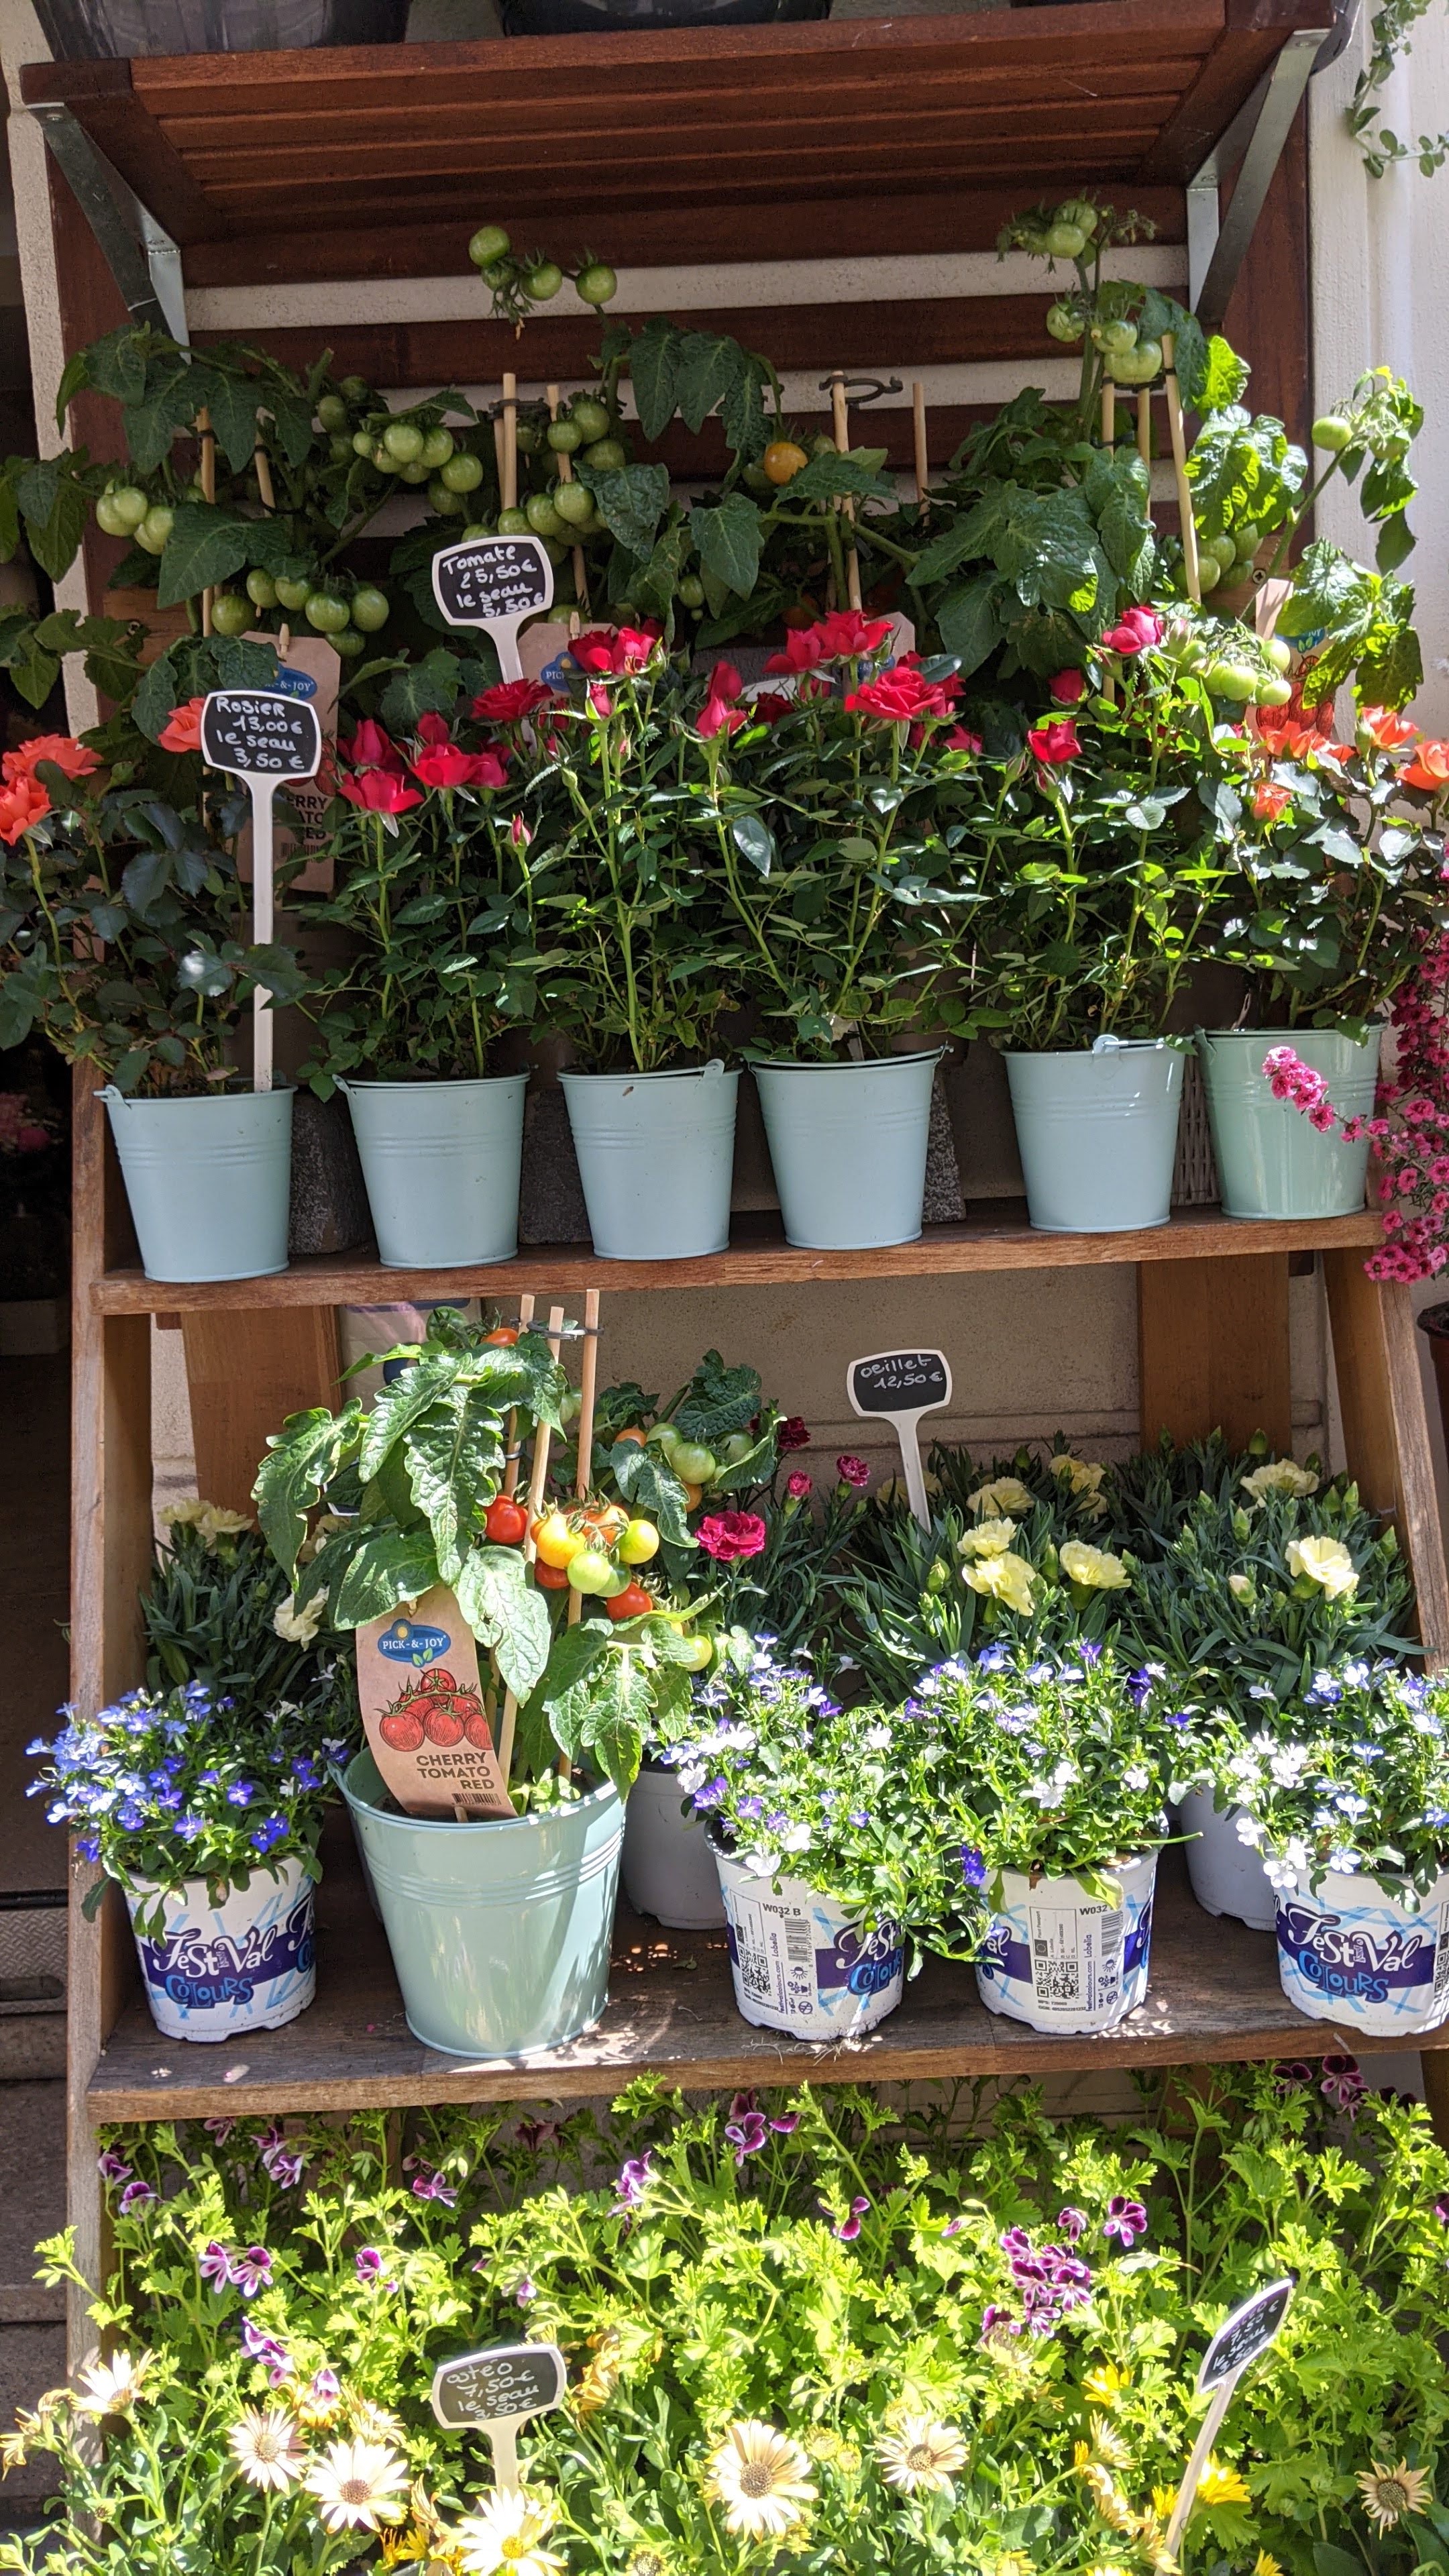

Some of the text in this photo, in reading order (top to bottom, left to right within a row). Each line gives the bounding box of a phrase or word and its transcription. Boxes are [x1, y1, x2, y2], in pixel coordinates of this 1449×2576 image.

[442, 544, 517, 575] Tomate
[456, 582, 533, 608] le seau
[216, 729, 297, 752] le seau
[416, 1752, 486, 1766] CHERRY
[417, 1766, 490, 1778] TOMATO
[462, 1779, 494, 1790] RED
[763, 1903, 790, 1915] W032
[1079, 1907, 1108, 1916] W032
[769, 1933, 779, 1957] Lobelia
[1083, 1935, 1092, 1957] Lobelia
[458, 2385, 539, 2412] le seau
